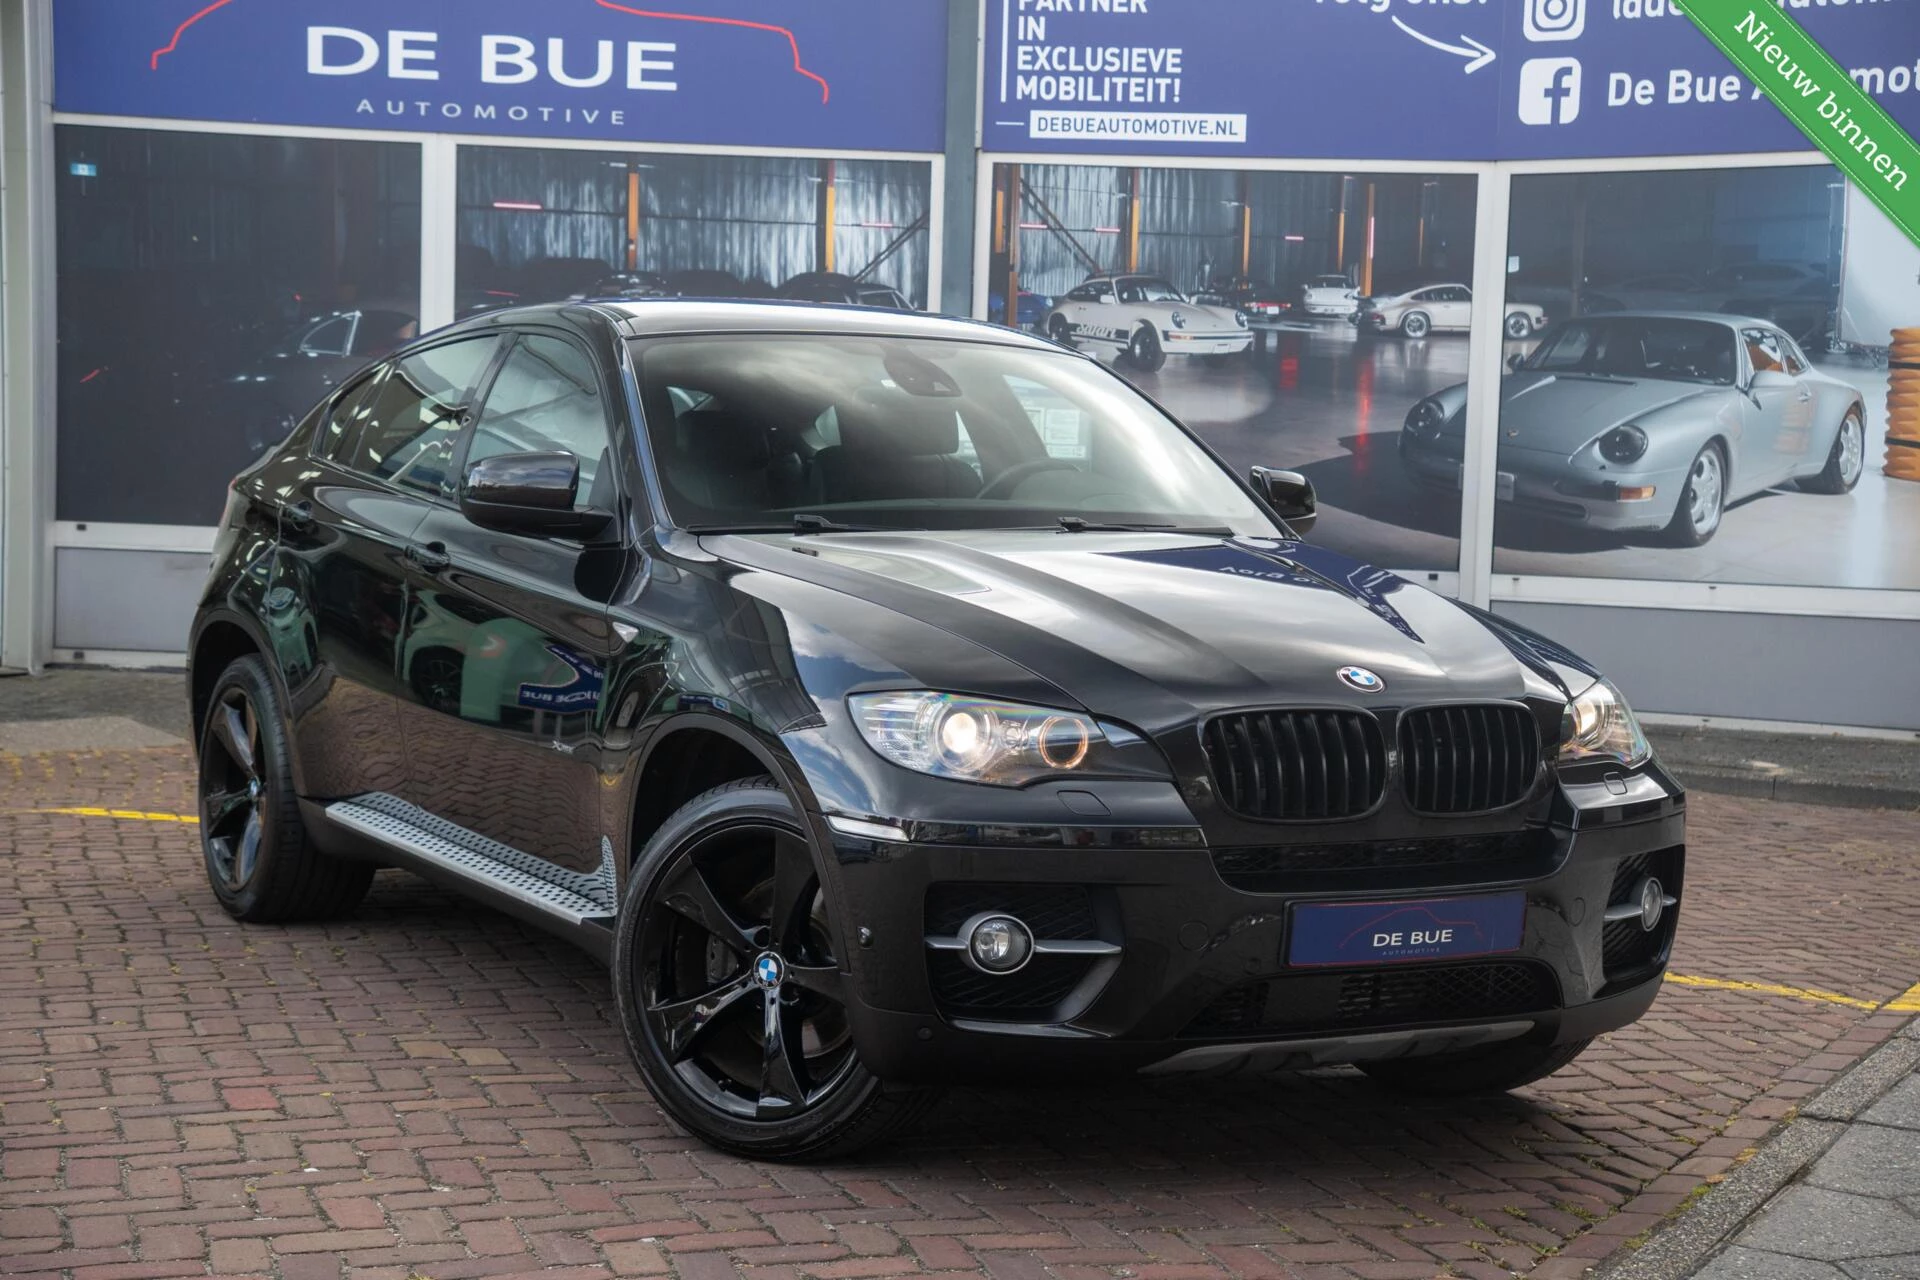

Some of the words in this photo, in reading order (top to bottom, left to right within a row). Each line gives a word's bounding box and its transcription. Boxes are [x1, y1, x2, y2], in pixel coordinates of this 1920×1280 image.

[1018, 16, 1046, 41] IN
[307, 26, 439, 80] DE
[481, 35, 678, 91] BUE
[1016, 45, 1183, 74] EXCLUSIEVE
[1016, 75, 1181, 103] MOBILITEIT!
[1608, 72, 1655, 106] De
[1668, 69, 1741, 104] Bue
[356, 99, 625, 125] AUTOMOTIVE
[1037, 116, 1238, 136] DEBUEAUTOMOTIVE.NL
[1373, 932, 1403, 947] DE
[1410, 929, 1453, 945] BUE
